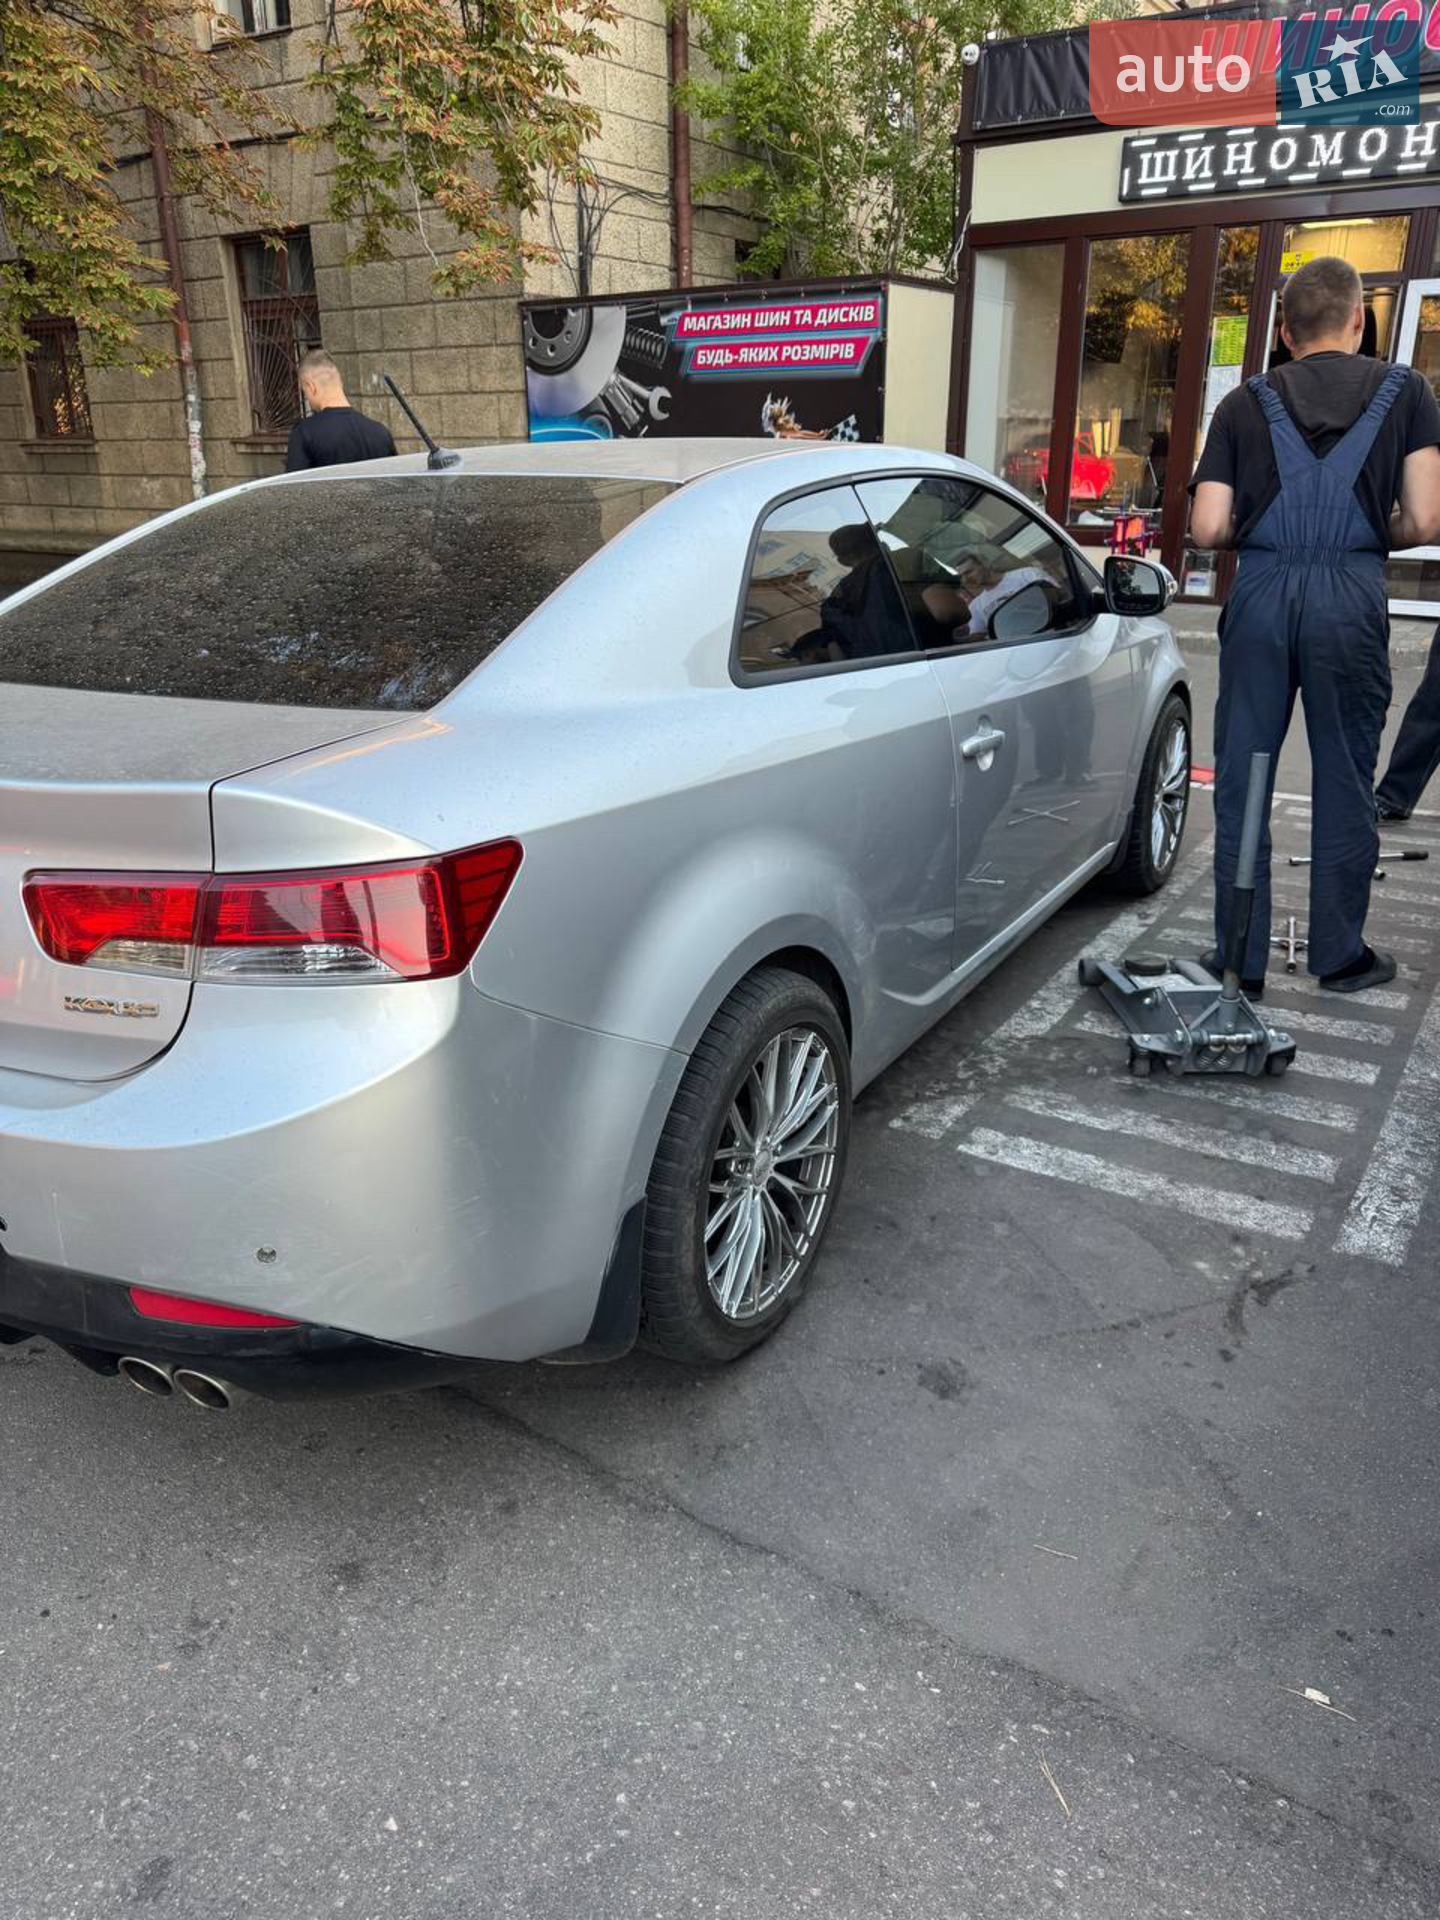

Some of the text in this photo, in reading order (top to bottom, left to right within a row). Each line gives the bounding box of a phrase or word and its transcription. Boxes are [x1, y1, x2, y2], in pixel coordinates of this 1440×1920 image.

[683, 305, 875, 331] МАГАЗИН ШИН ТА ДИСКІВ
[696, 343, 855, 367] БУДЬ-ЯКИХ РОЗМІРІВ
